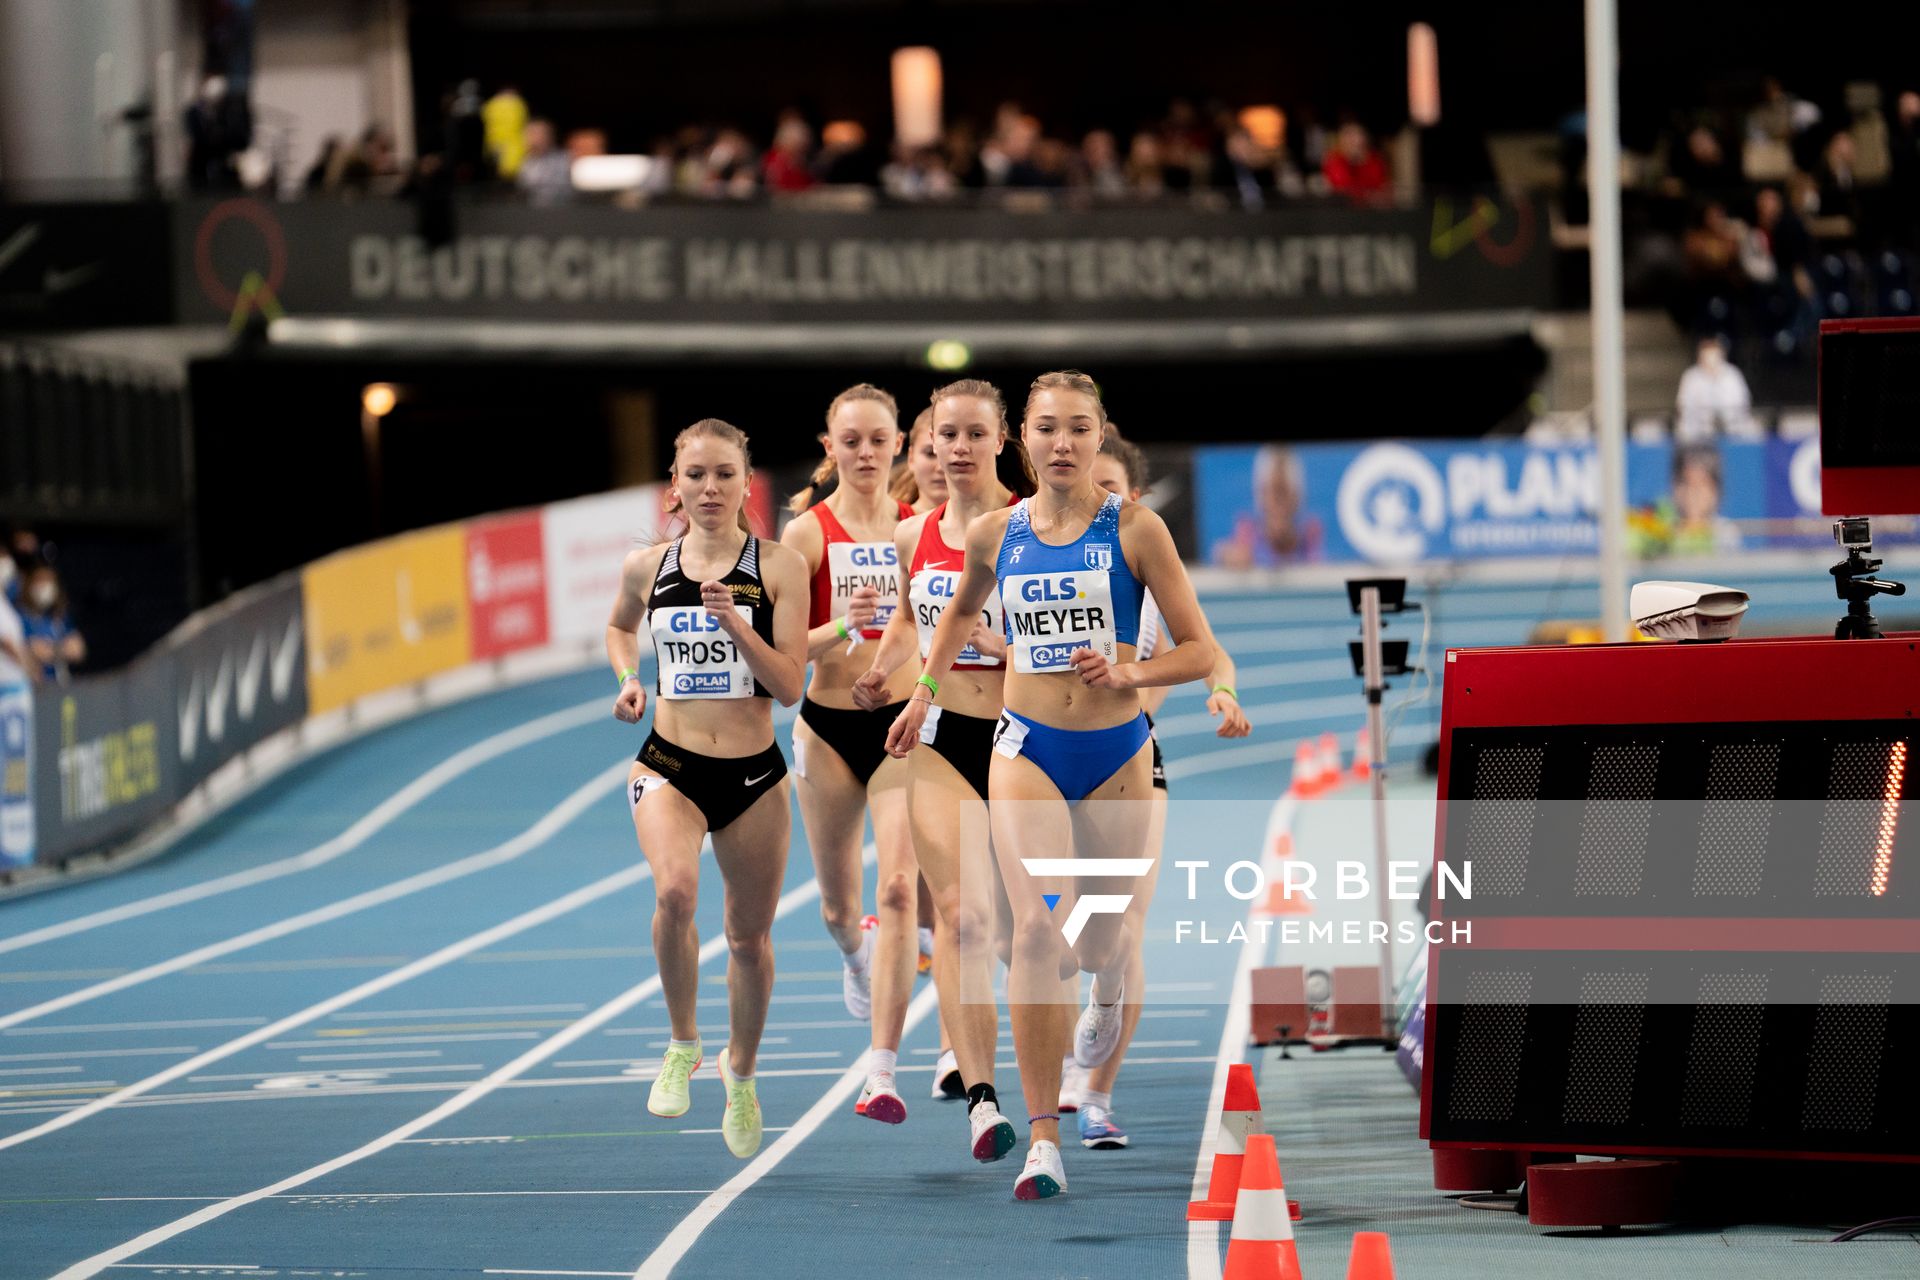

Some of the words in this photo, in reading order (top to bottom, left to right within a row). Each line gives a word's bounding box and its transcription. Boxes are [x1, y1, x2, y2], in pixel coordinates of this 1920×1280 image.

[350, 235, 673, 300] DEUTSCHE
[685, 234, 1416, 301] HALLENMEISTERSCHAFTEN
[1446, 452, 1602, 518] PLAN
[850, 547, 898, 567] GLS
[927, 575, 955, 598] GL
[670, 611, 721, 634] GLS
[1014, 606, 1106, 636] MEYER
[663, 640, 739, 665] TROST
[695, 675, 729, 687] PLAN
